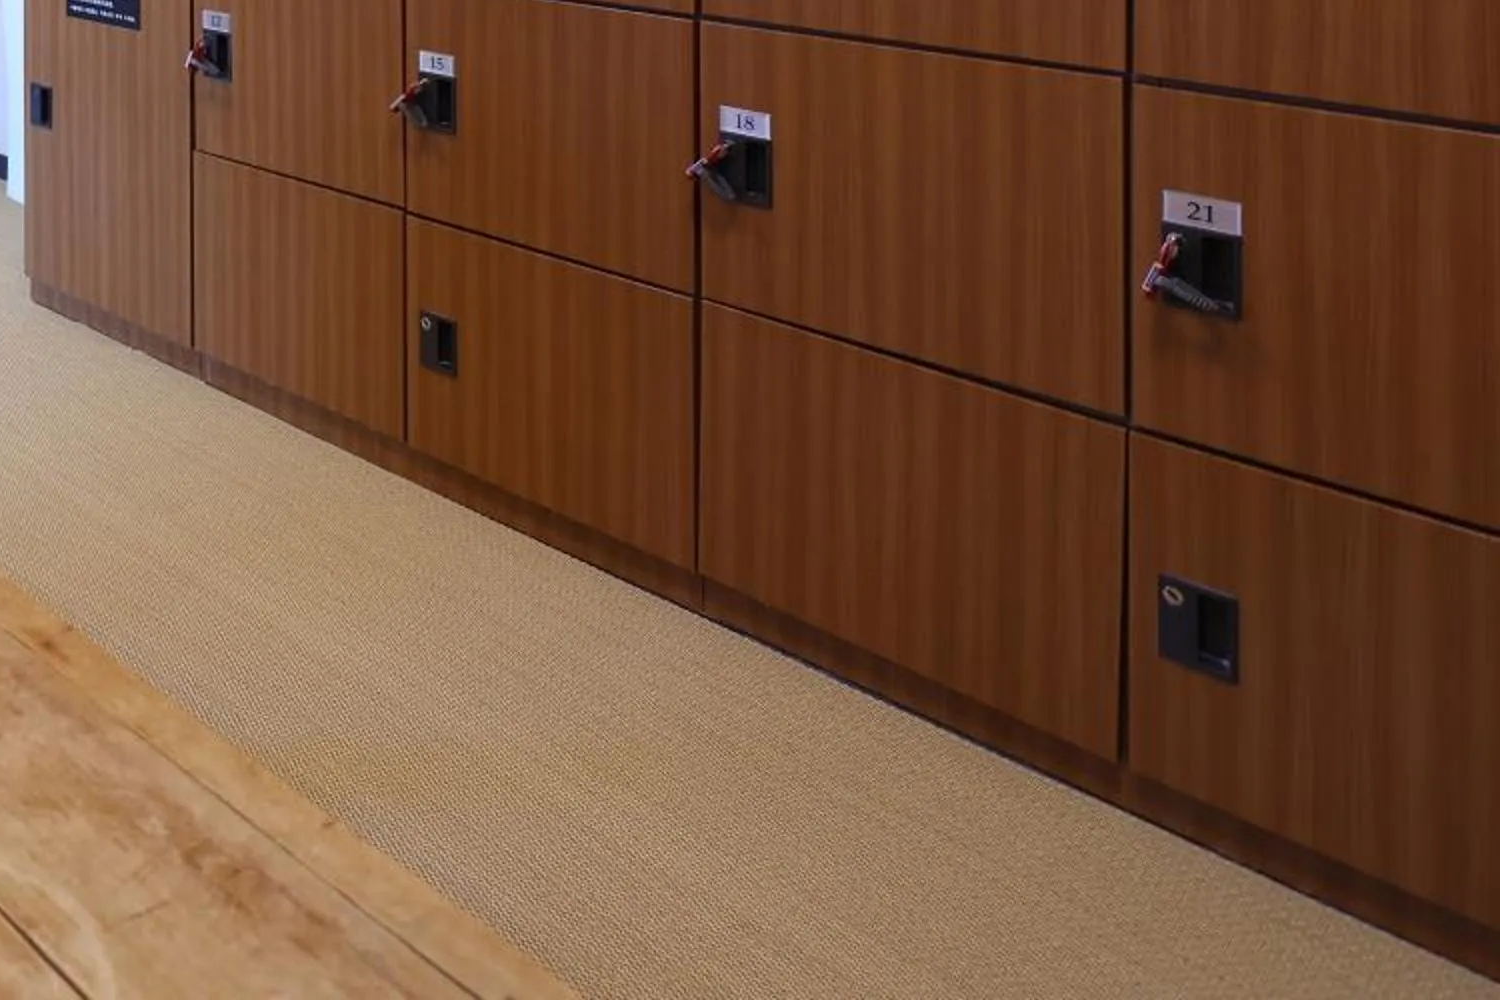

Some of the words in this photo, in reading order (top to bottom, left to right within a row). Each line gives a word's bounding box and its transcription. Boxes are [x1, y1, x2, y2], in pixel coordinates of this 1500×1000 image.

[431, 57, 445, 71] 15
[736, 113, 755, 130] 18
[1187, 201, 1215, 224] 21
